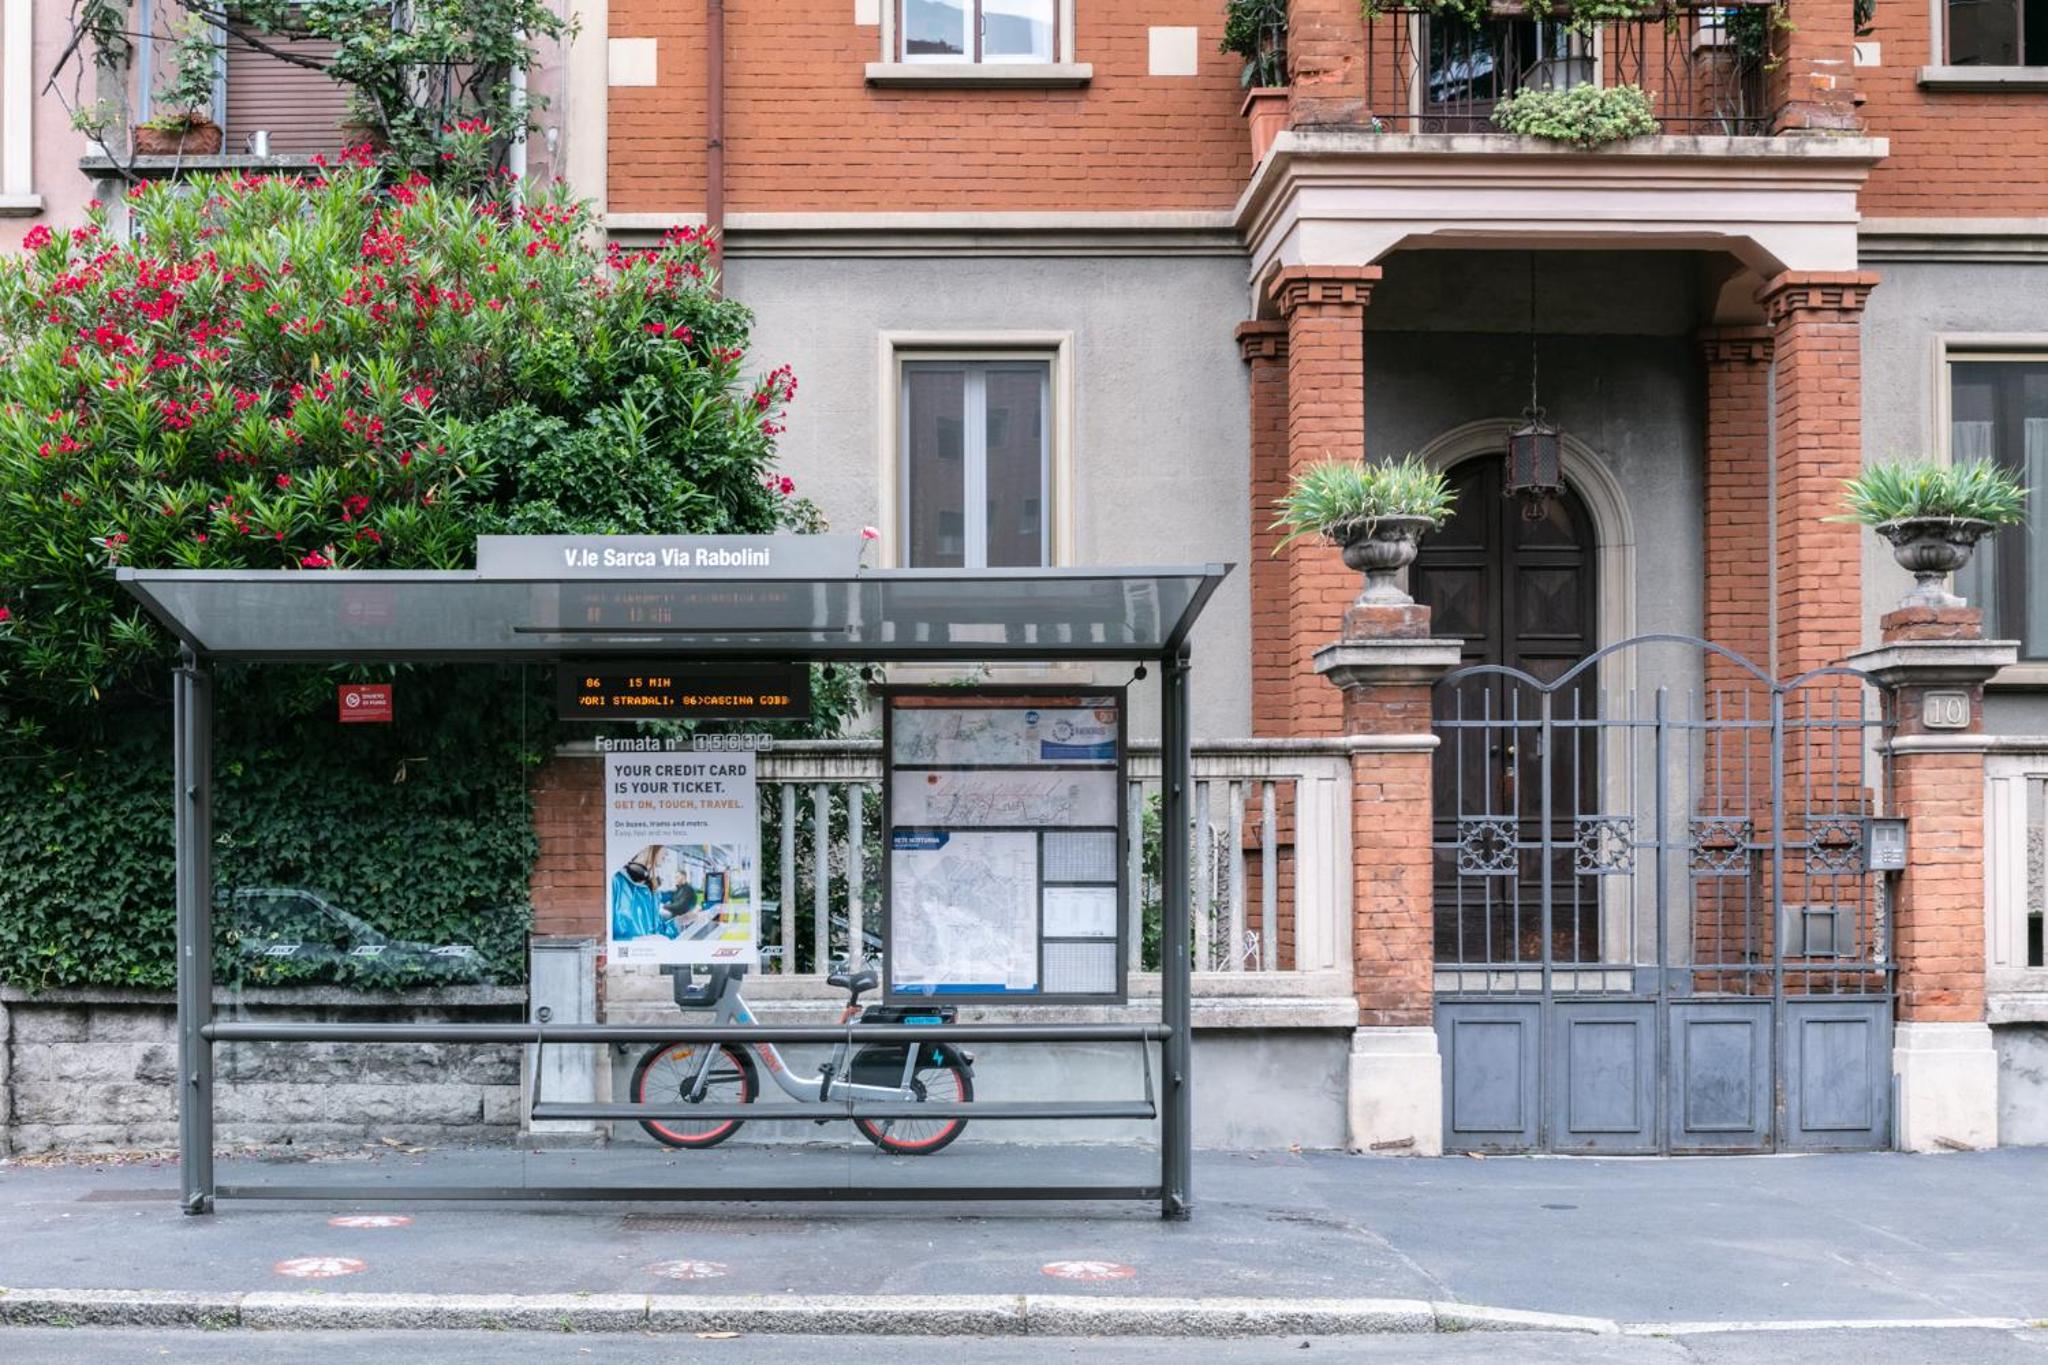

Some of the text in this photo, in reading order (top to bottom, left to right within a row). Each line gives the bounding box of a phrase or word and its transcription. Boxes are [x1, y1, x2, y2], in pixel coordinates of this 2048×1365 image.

[565, 548, 769, 566] V.le Sarca Via Rabolini
[586, 678, 600, 687] 86
[629, 678, 643, 687] 15
[1932, 698, 1963, 723] 10
[595, 736, 660, 751] Fermata
[694, 734, 772, 751] 15634
[614, 765, 746, 776] YOUR CREDIT CARD
[615, 782, 725, 794] IS YOUR TICKET.
[614, 801, 634, 809] GET
[659, 800, 697, 810] TOUCH,
[700, 800, 743, 808] TRAVEL.
